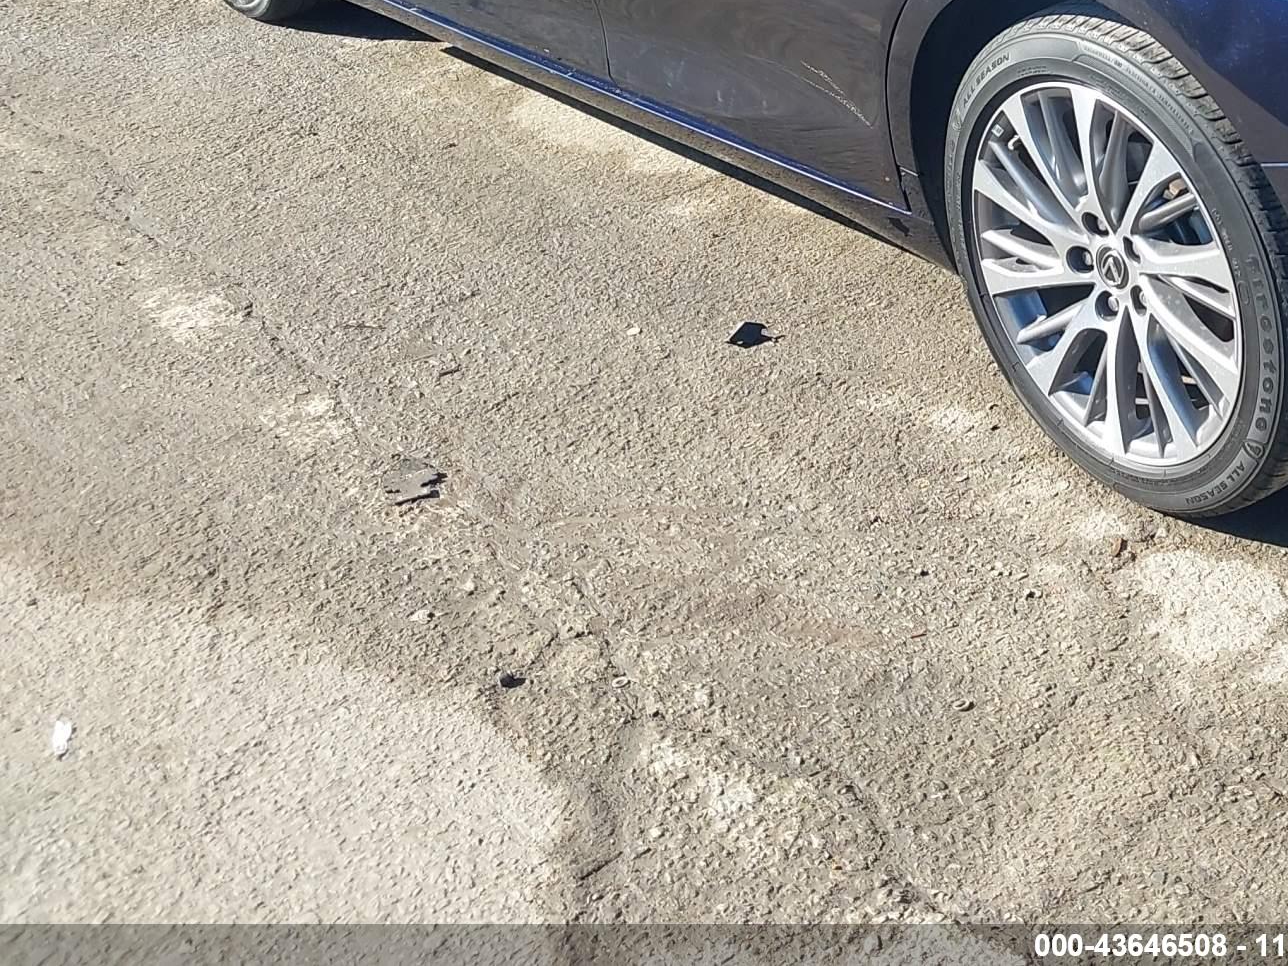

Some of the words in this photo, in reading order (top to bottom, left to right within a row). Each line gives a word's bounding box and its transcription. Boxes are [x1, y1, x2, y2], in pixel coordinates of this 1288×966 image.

[962, 84, 976, 108] ALL
[975, 53, 1011, 85] SEASON
[1246, 254, 1277, 432] Firestone
[1226, 460, 1246, 483] ALL
[1184, 480, 1229, 505] SEASON
